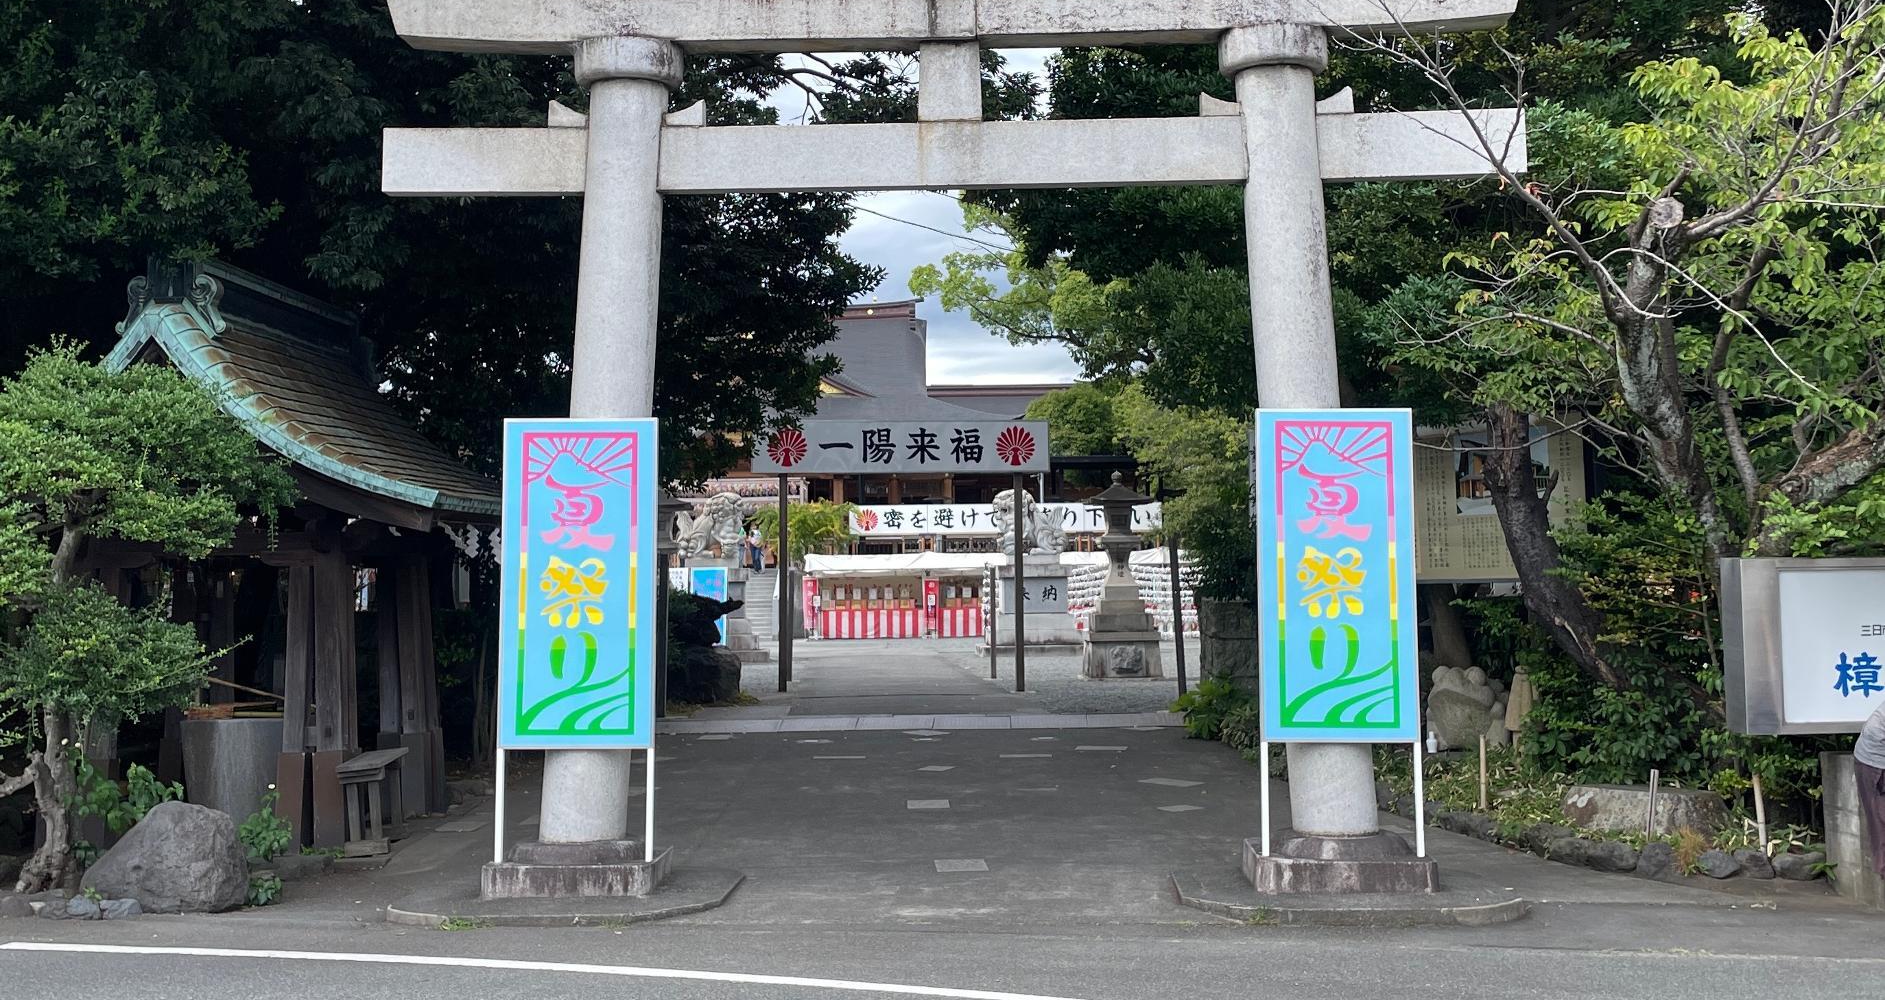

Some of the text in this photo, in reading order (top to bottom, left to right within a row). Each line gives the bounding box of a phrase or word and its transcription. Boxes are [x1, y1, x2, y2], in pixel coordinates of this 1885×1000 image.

[818, 425, 985, 465] 一陽来福
[883, 507, 1151, 529] 密を避けてり下い
[539, 473, 616, 690] 夏祭り
[1296, 461, 1372, 682] 夏祭り
[1833, 651, 1885, 698] 樟
